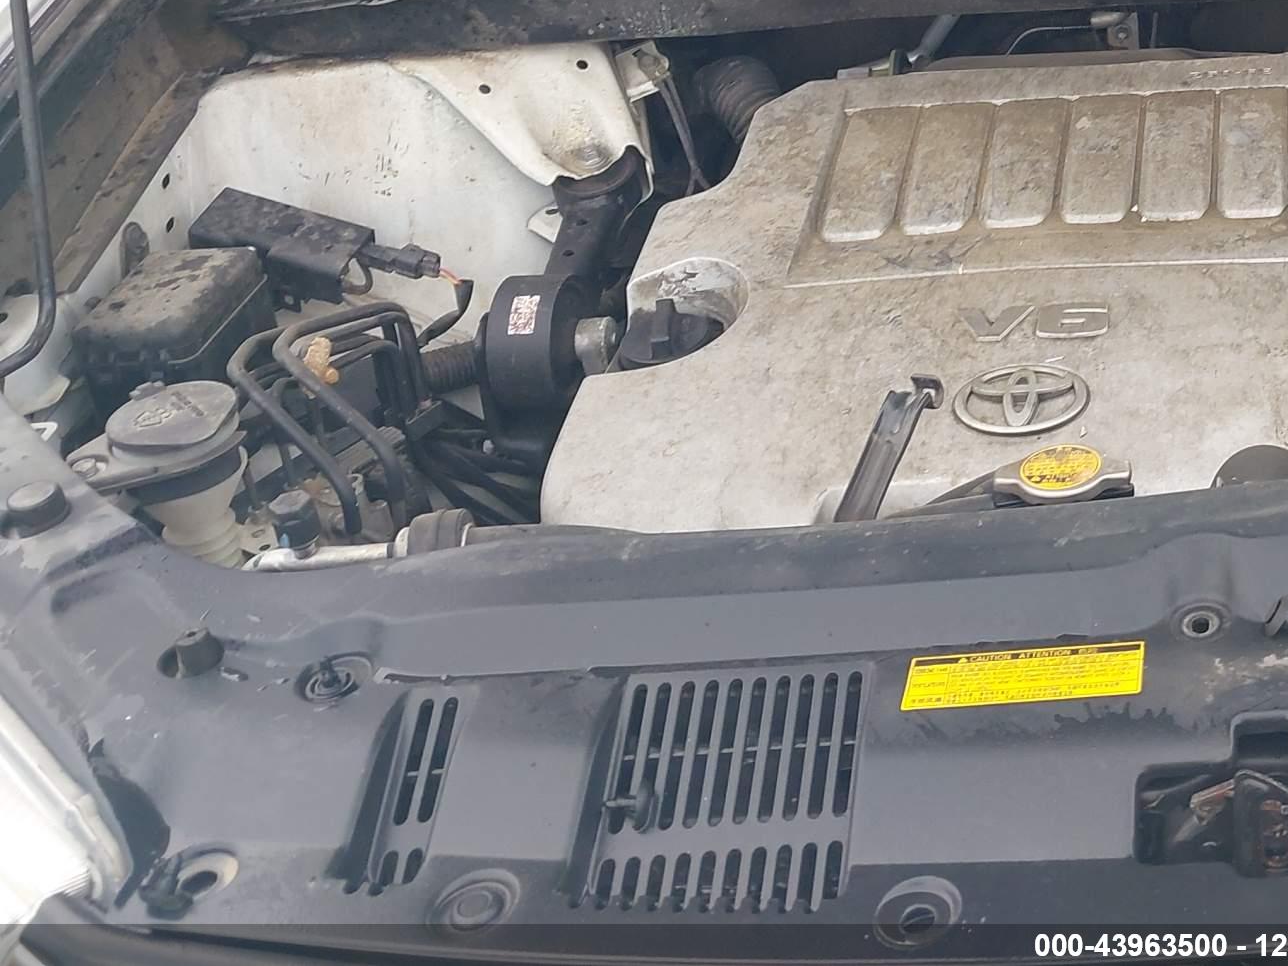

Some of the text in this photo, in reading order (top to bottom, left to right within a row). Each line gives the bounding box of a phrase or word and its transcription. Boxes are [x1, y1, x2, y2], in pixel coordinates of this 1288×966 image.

[957, 301, 1109, 342] V6
[970, 652, 1011, 663] CAUTION
[1019, 649, 1071, 659] ATTENTION
